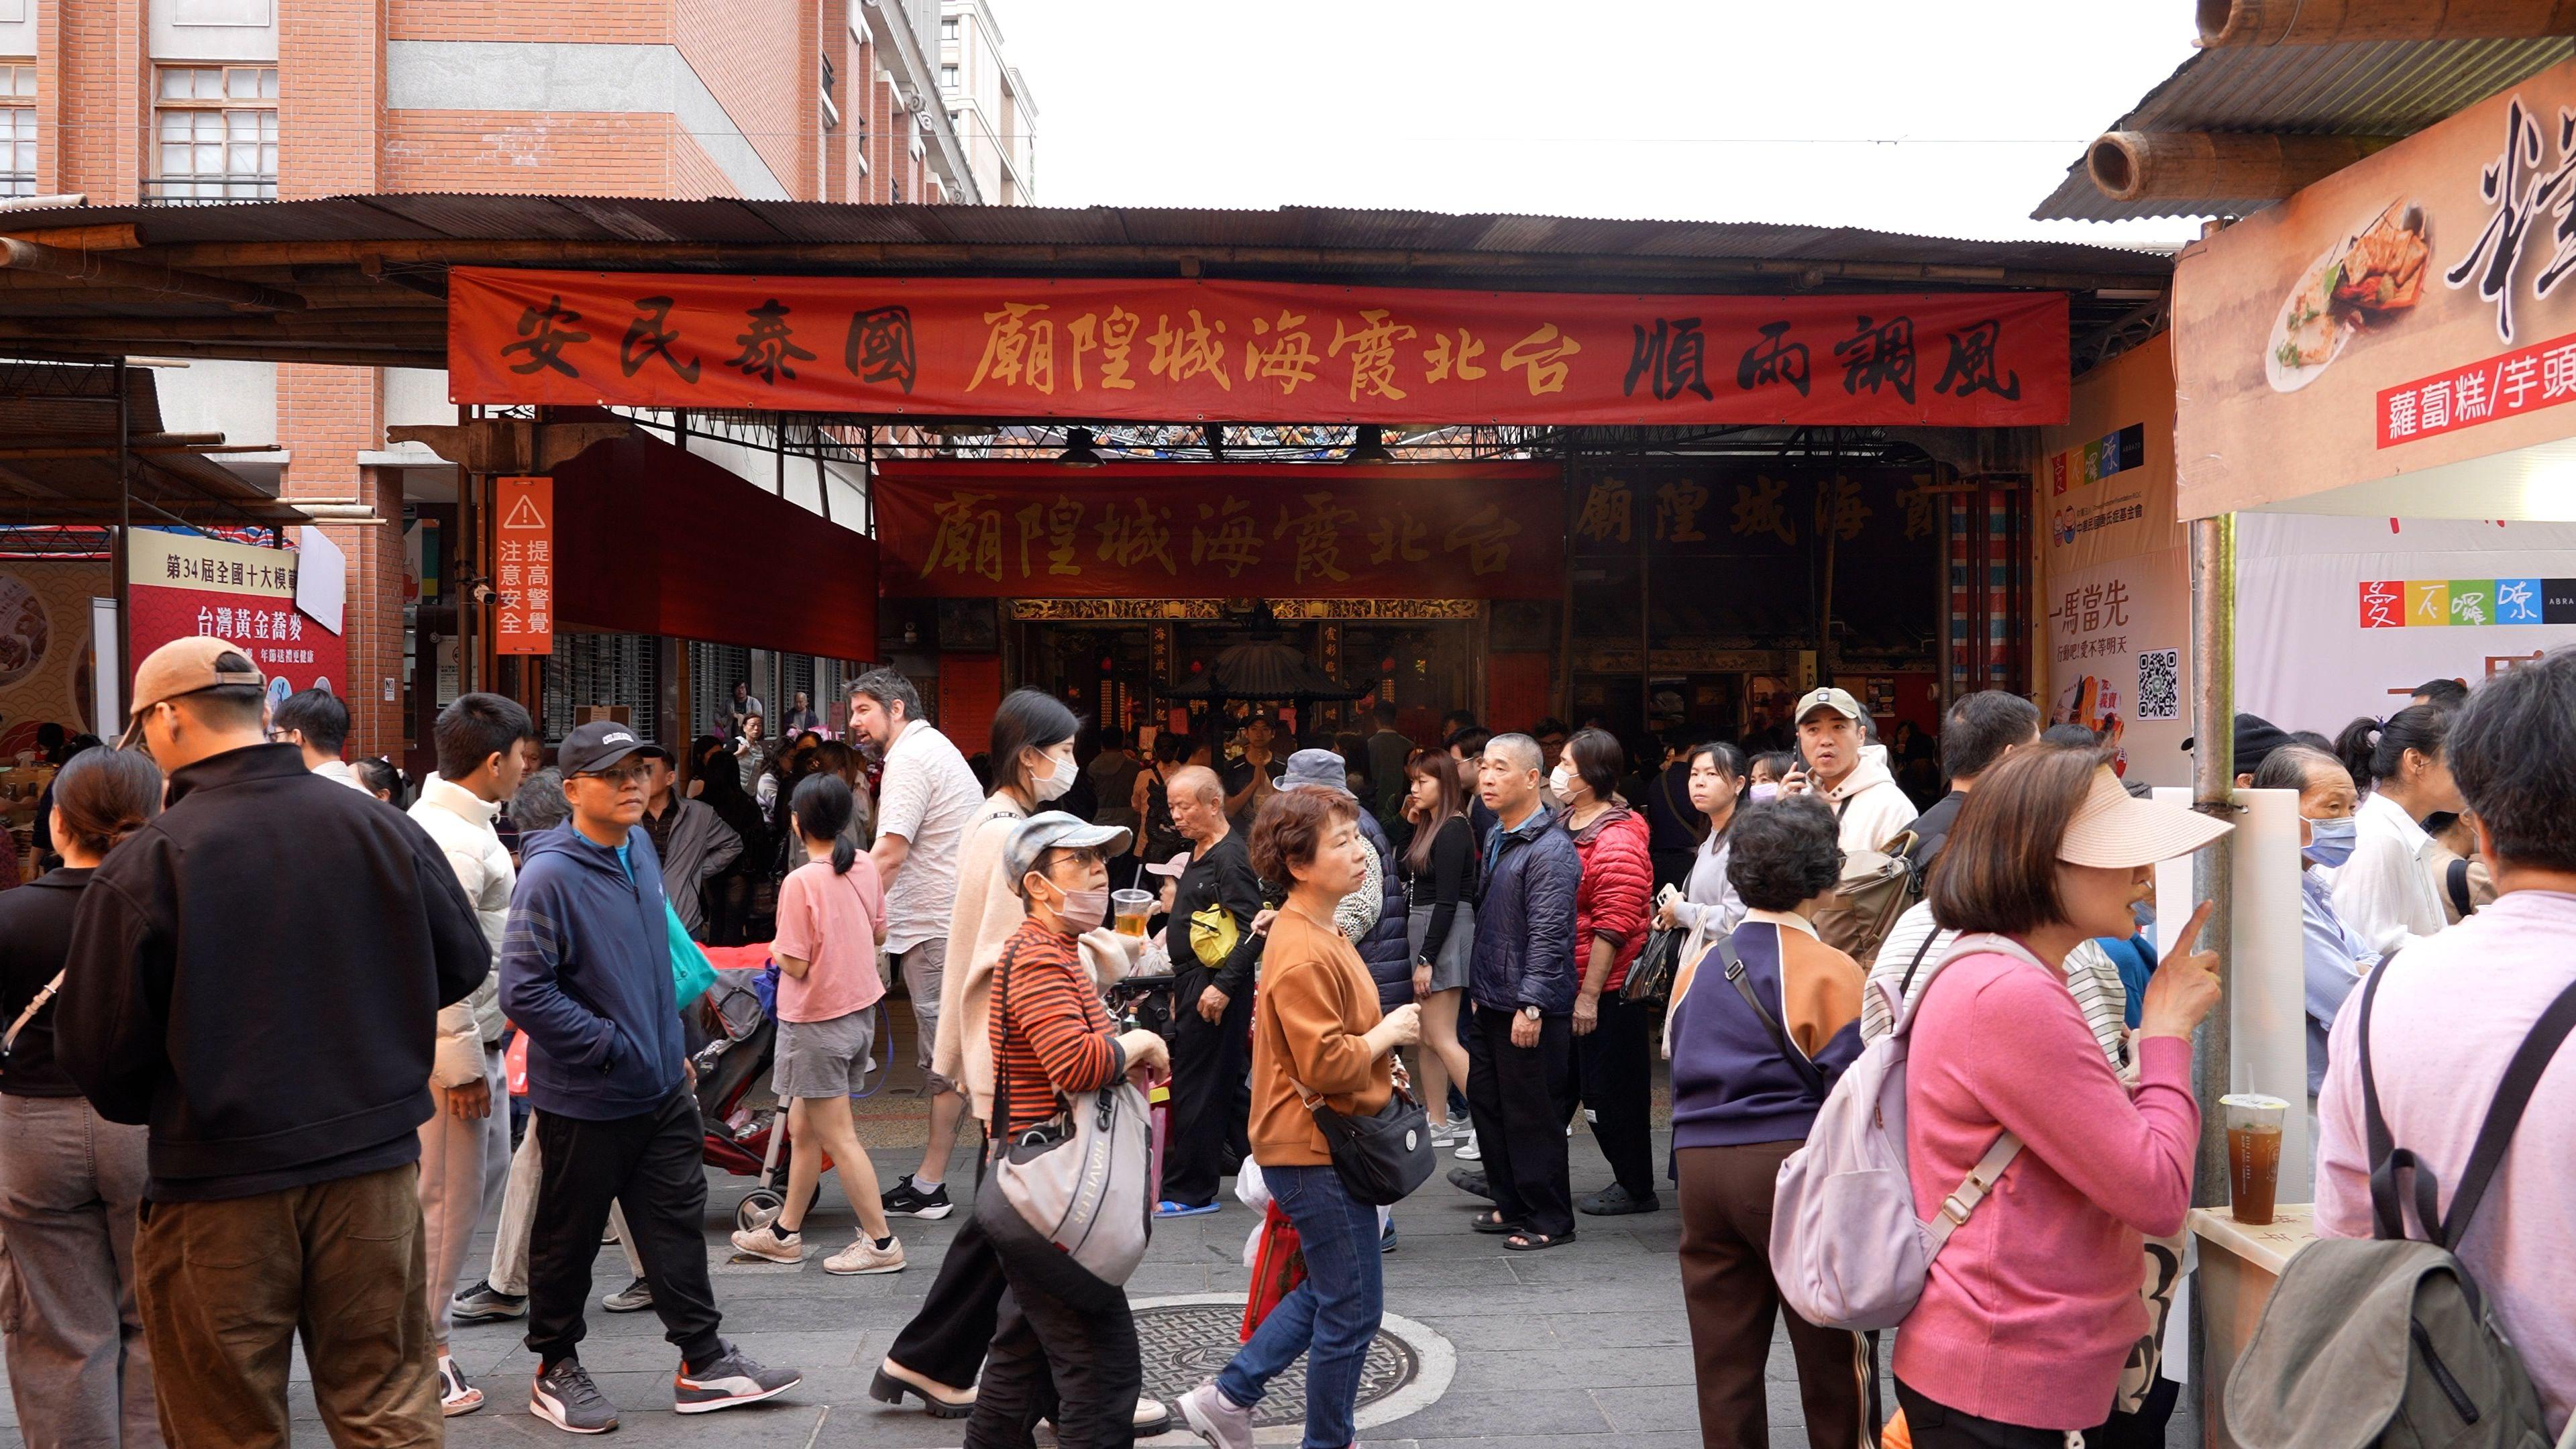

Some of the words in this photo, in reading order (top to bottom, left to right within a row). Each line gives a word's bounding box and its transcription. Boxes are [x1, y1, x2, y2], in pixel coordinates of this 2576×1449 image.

[965, 301, 1582, 402] 台北霞海城隍廟
[197, 606, 303, 642] 台灣黃金蕎麥
[500, 540, 523, 634] 注意安全
[527, 540, 549, 635] 提高警覺
[2049, 579, 2129, 635] 一馬當先
[1075, 1140, 1105, 1224] TRAVELER
